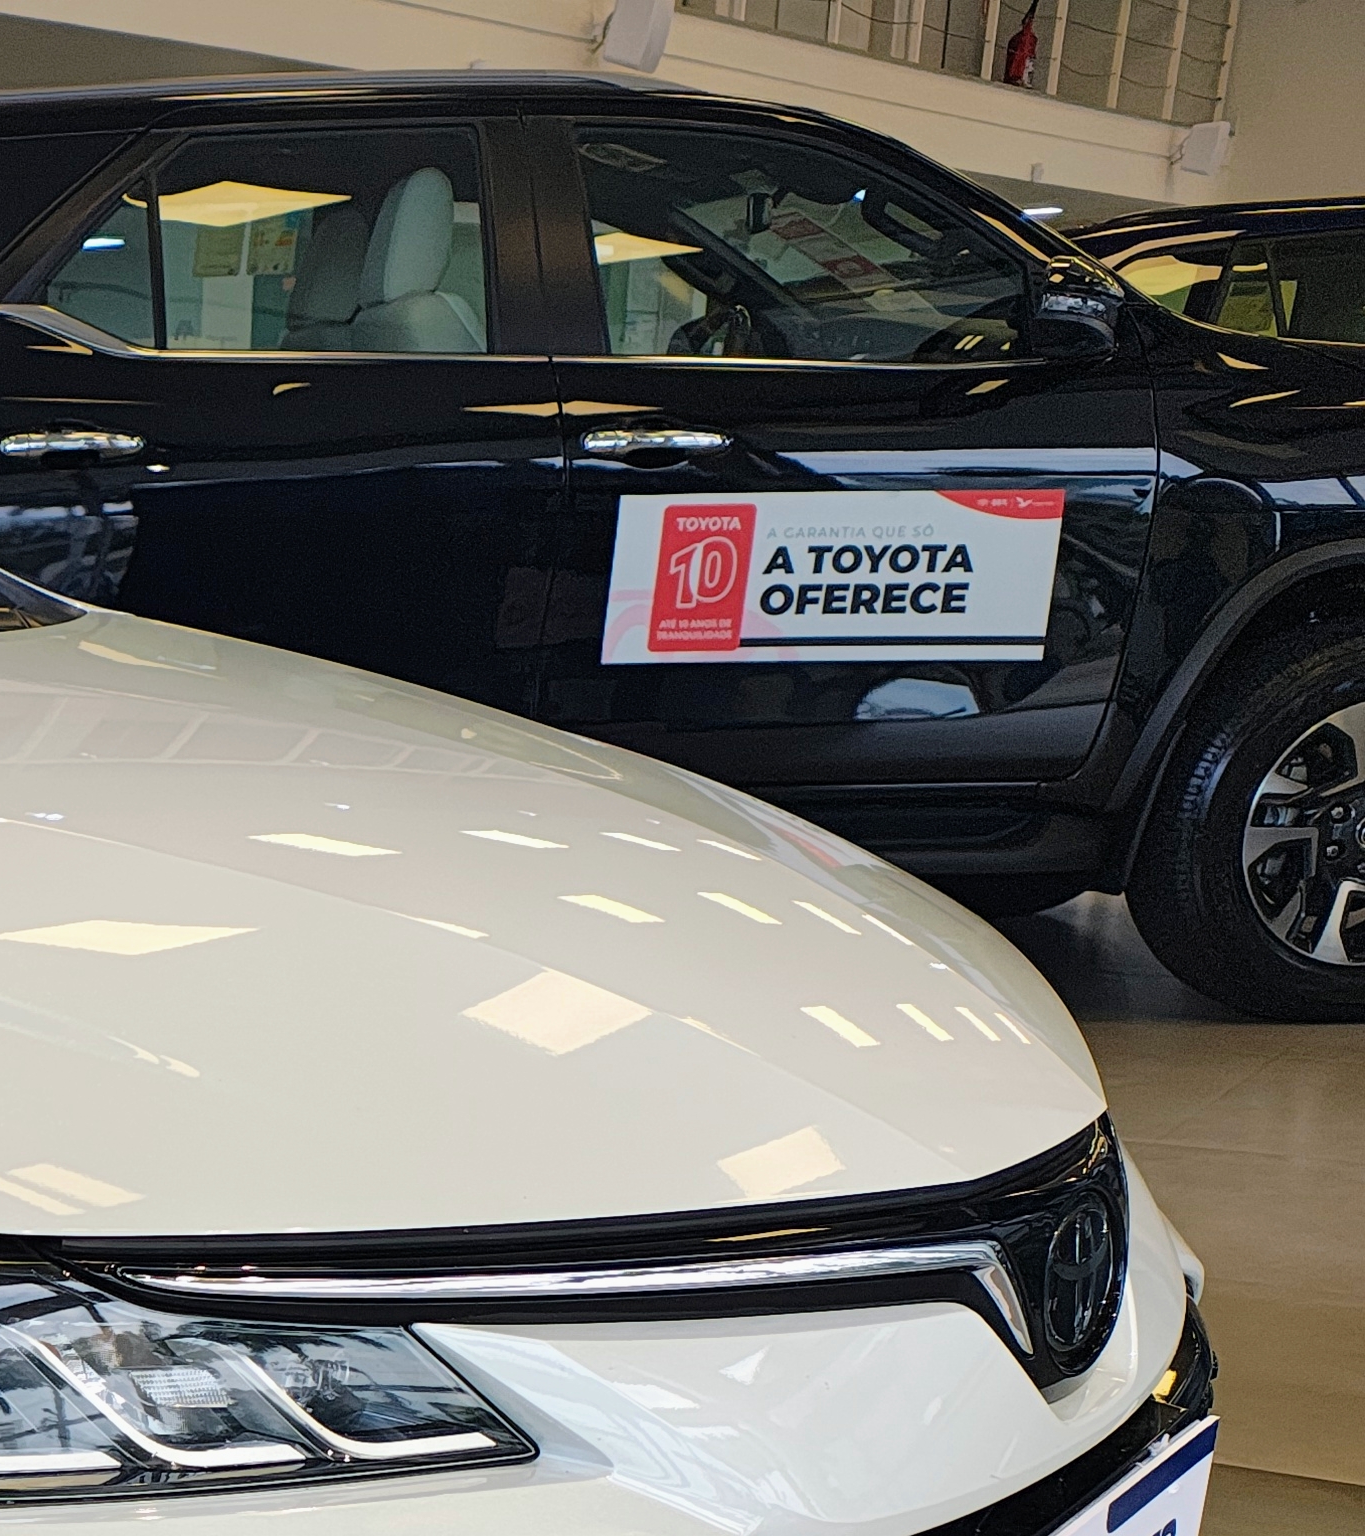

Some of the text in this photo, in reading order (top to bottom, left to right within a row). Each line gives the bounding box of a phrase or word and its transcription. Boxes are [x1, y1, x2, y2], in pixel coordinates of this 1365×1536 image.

[676, 516, 741, 532] TOYOTA
[767, 527, 777, 539] A
[783, 526, 866, 539] GARANTIA
[871, 525, 907, 539] QUE
[669, 535, 738, 609] 10
[762, 544, 974, 575] A TOYOTA
[760, 582, 970, 616] OFERECE
